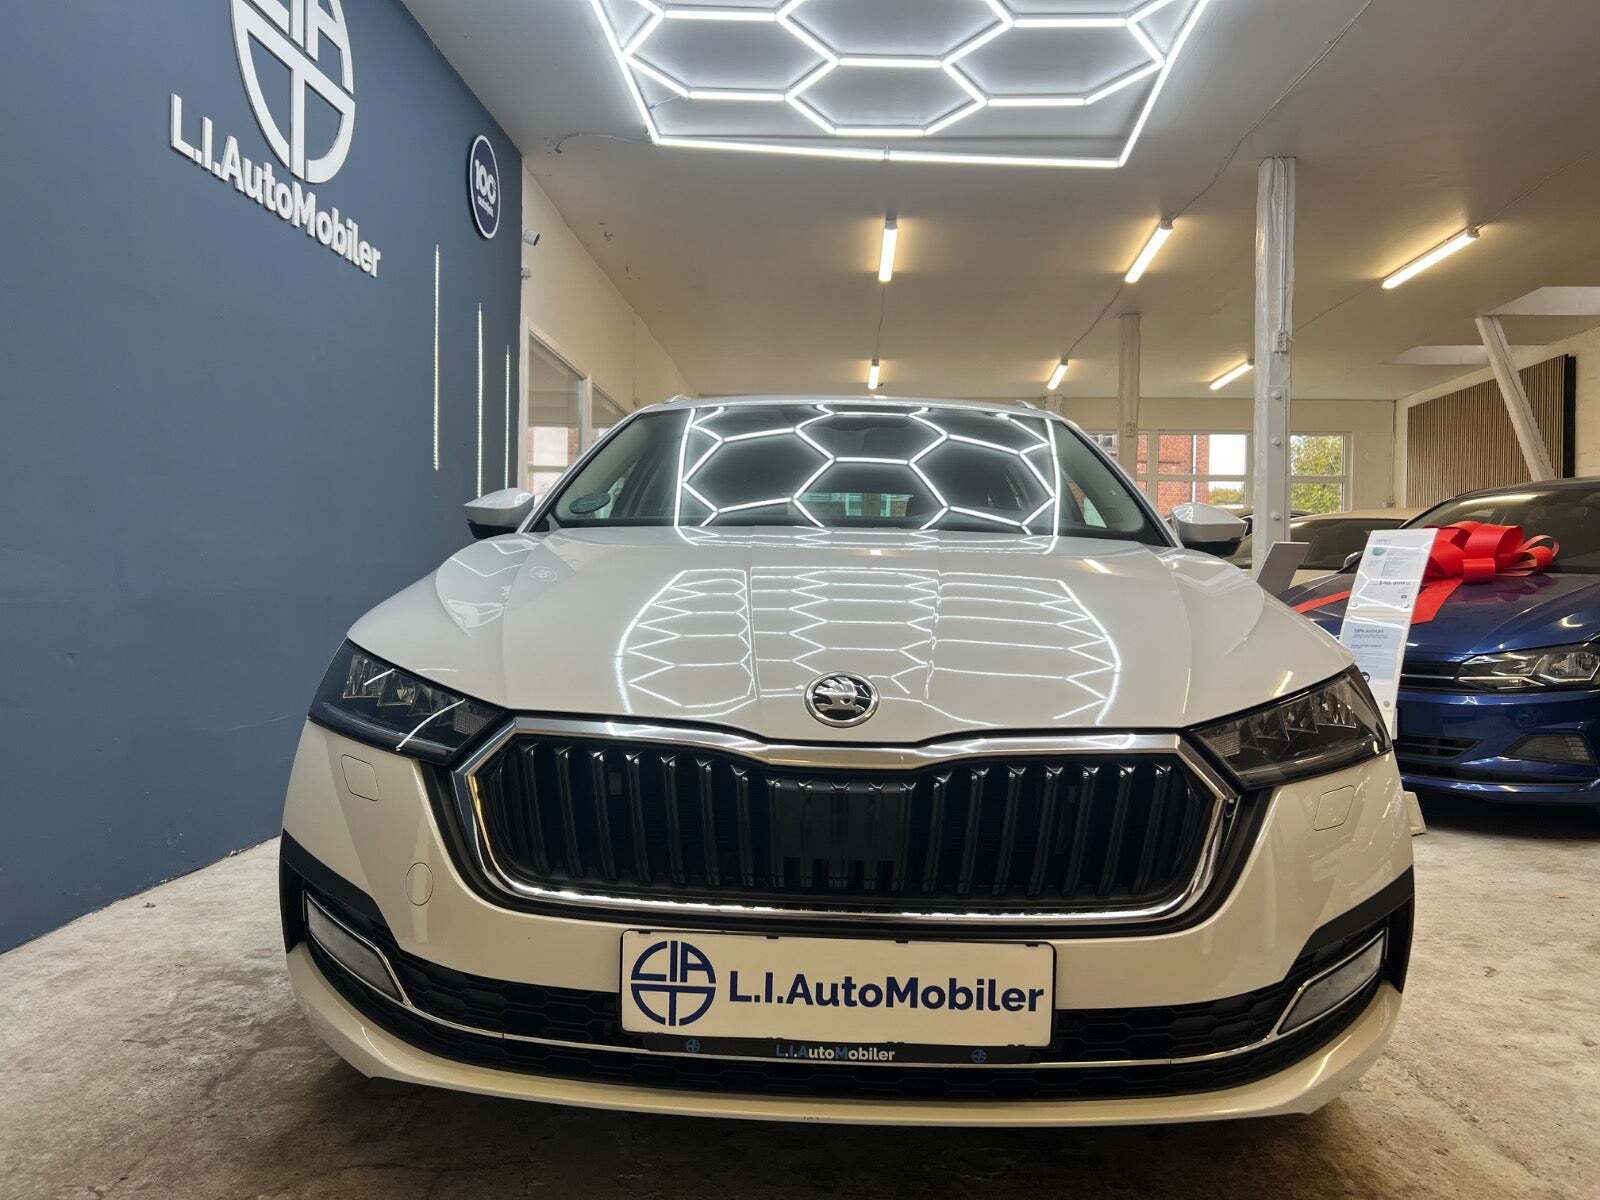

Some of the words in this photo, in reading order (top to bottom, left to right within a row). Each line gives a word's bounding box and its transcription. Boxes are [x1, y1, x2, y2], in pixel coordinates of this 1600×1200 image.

[170, 94, 382, 278] L.I.AutoMobiler
[729, 970, 1045, 1013] L.I.AutoMobiler
[775, 1043, 896, 1063] L.I.AutoMobiler
